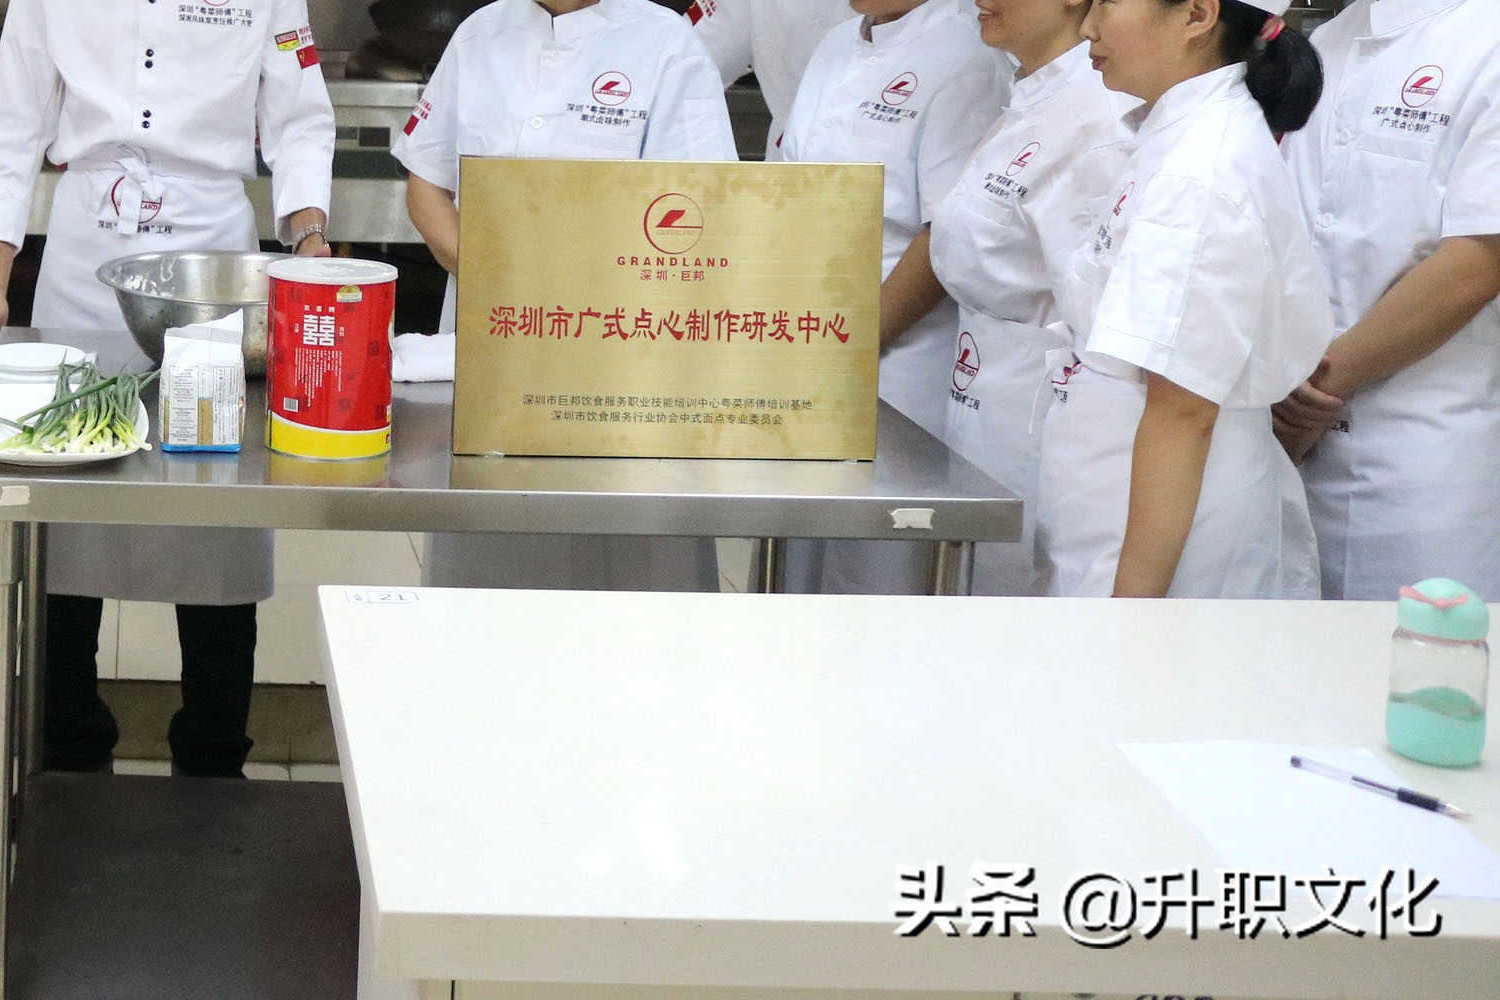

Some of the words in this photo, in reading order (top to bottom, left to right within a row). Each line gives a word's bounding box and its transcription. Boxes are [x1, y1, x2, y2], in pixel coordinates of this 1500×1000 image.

[617, 256, 728, 267] GRANDLAND
[489, 305, 850, 344] 深圳市广式点心制作研发中心
[523, 394, 812, 410] 深圳市巨邦饮食服务职业技能培训中心粤菜师傅培训基地
[551, 410, 782, 425] 深圳市饮食服务行业协会中式面点专业委员会
